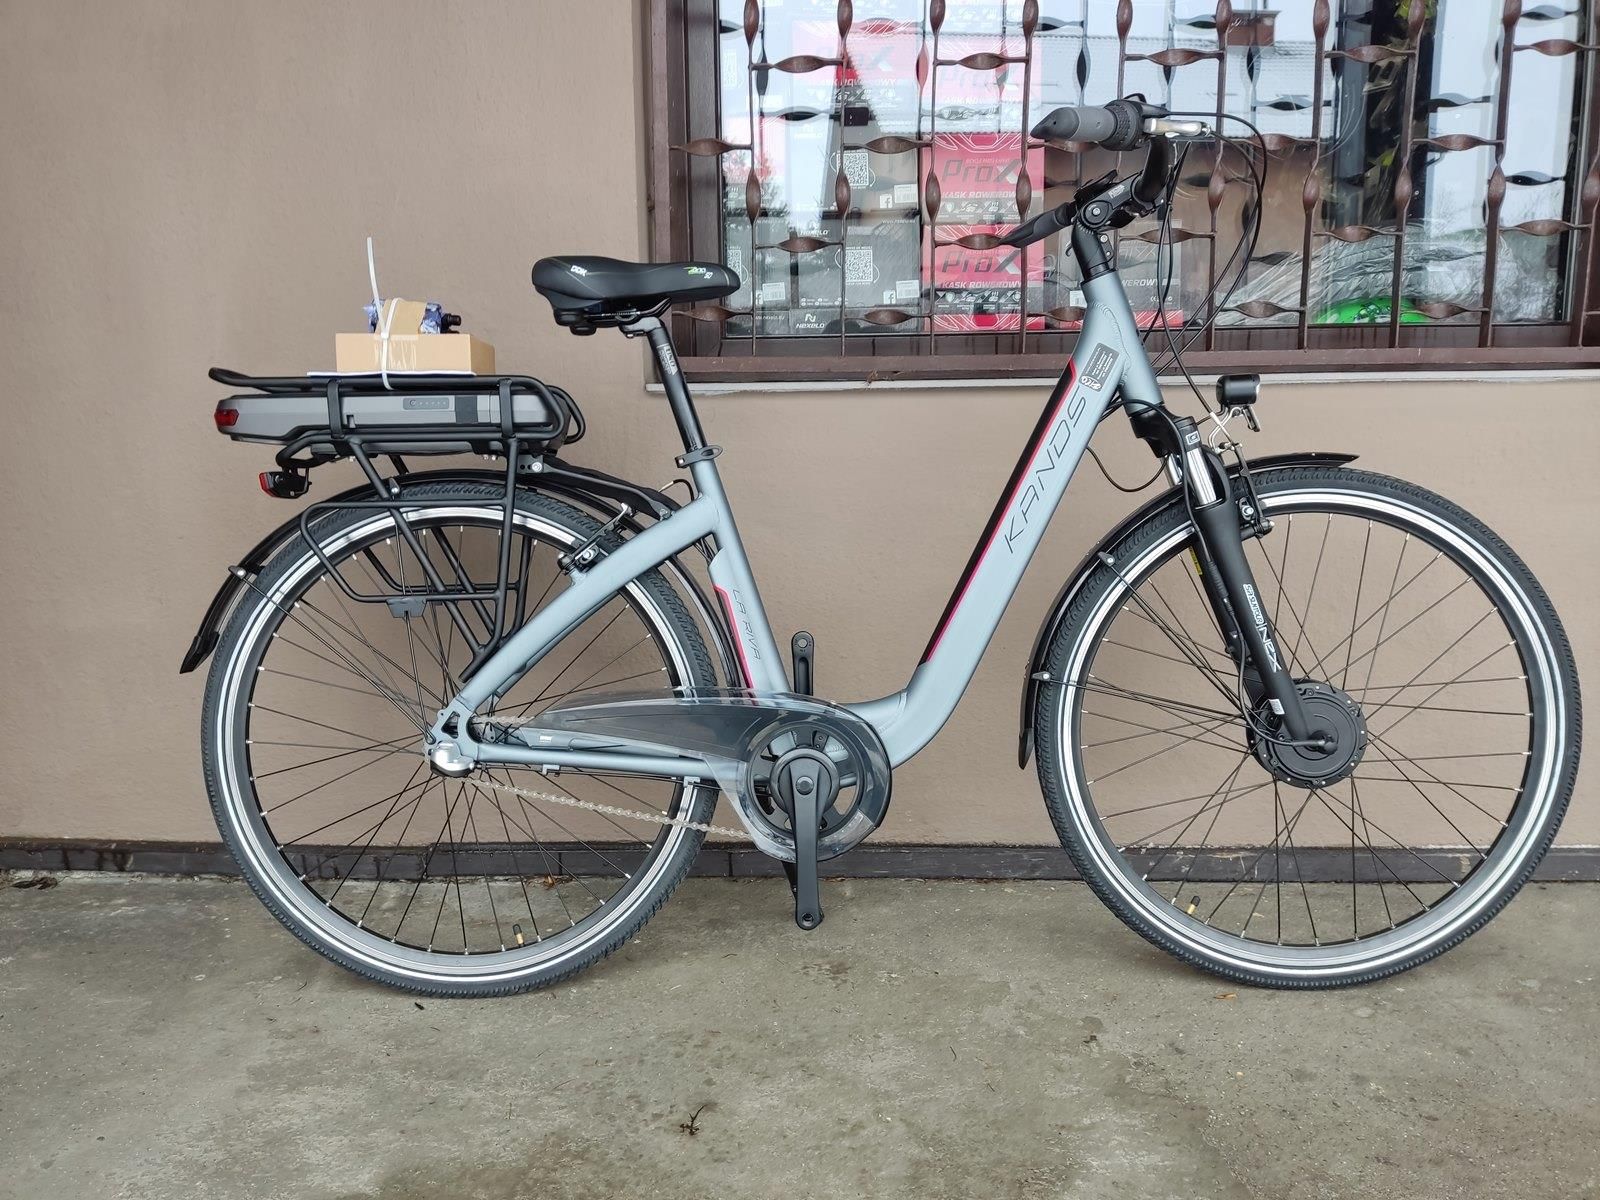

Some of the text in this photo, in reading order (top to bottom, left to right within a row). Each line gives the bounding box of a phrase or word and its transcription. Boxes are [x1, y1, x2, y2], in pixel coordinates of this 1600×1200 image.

[941, 158, 1021, 184] ProX
[941, 191, 1017, 199] KASK ROWEROW
[941, 249, 1021, 275] ProX
[942, 281, 966, 289] KASK
[1004, 385, 1087, 554] KANDS
[733, 589, 761, 660] LA RIVA
